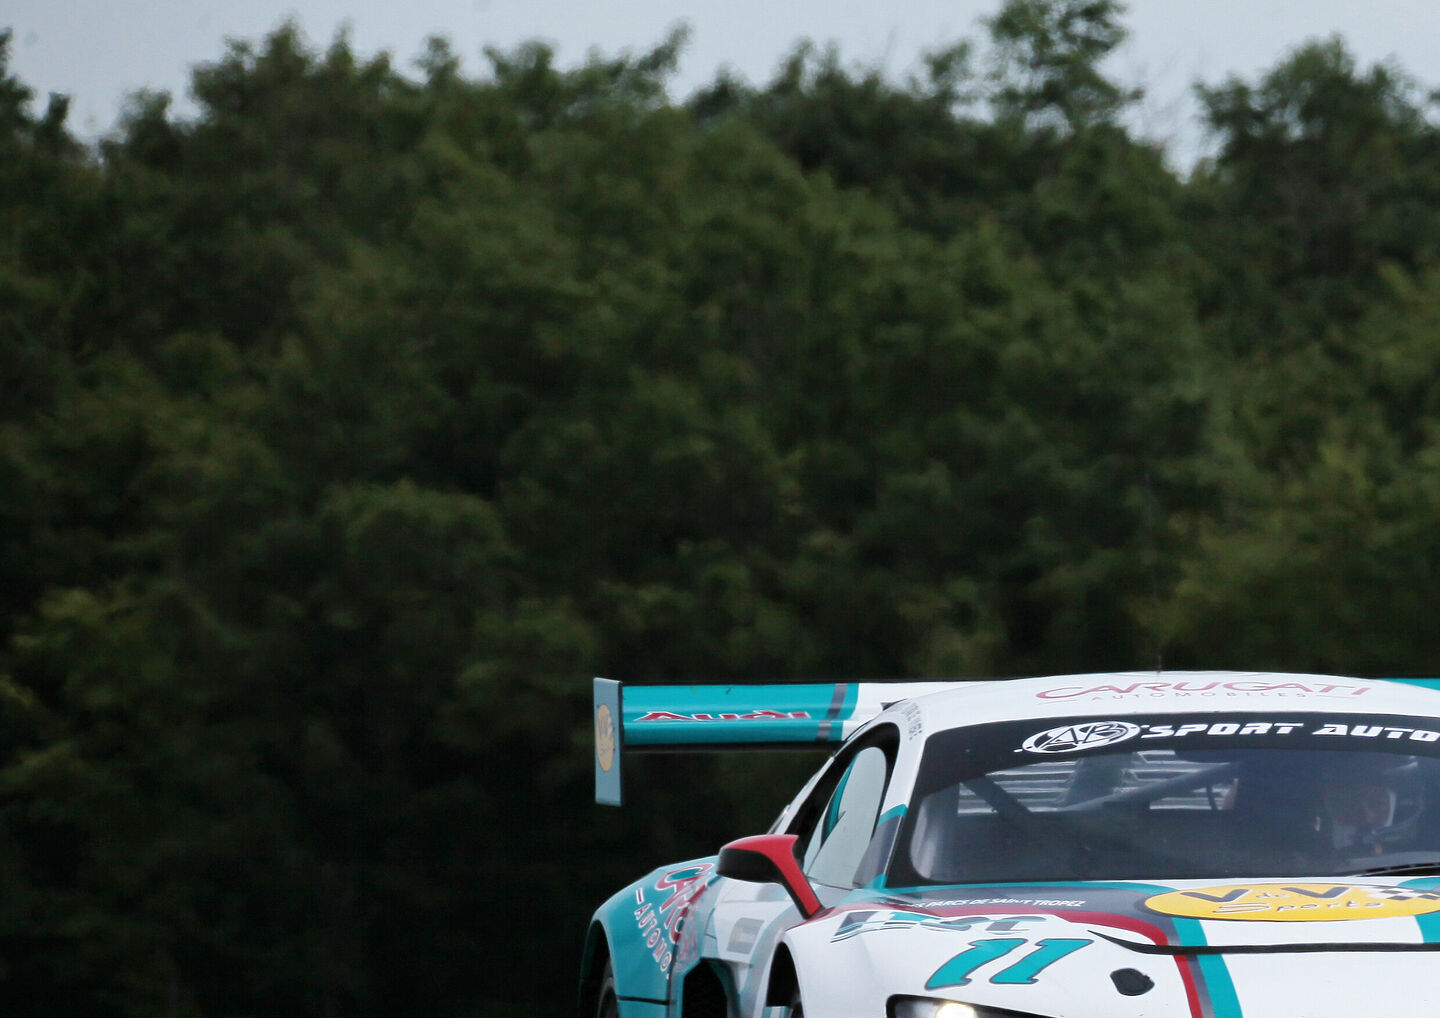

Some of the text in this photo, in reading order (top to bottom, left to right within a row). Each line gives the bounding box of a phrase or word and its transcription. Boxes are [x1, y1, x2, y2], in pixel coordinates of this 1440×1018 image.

[1035, 681, 1372, 700] CARUGATI
[1091, 691, 1306, 701] AUTOMOBILES
[1141, 722, 1304, 739] SPORT
[1312, 723, 1440, 742] AUTO
[1180, 888, 1252, 903] V
[1280, 886, 1351, 899] V
[1031, 900, 1087, 908] TROPEZ
[924, 937, 1094, 991] 11
